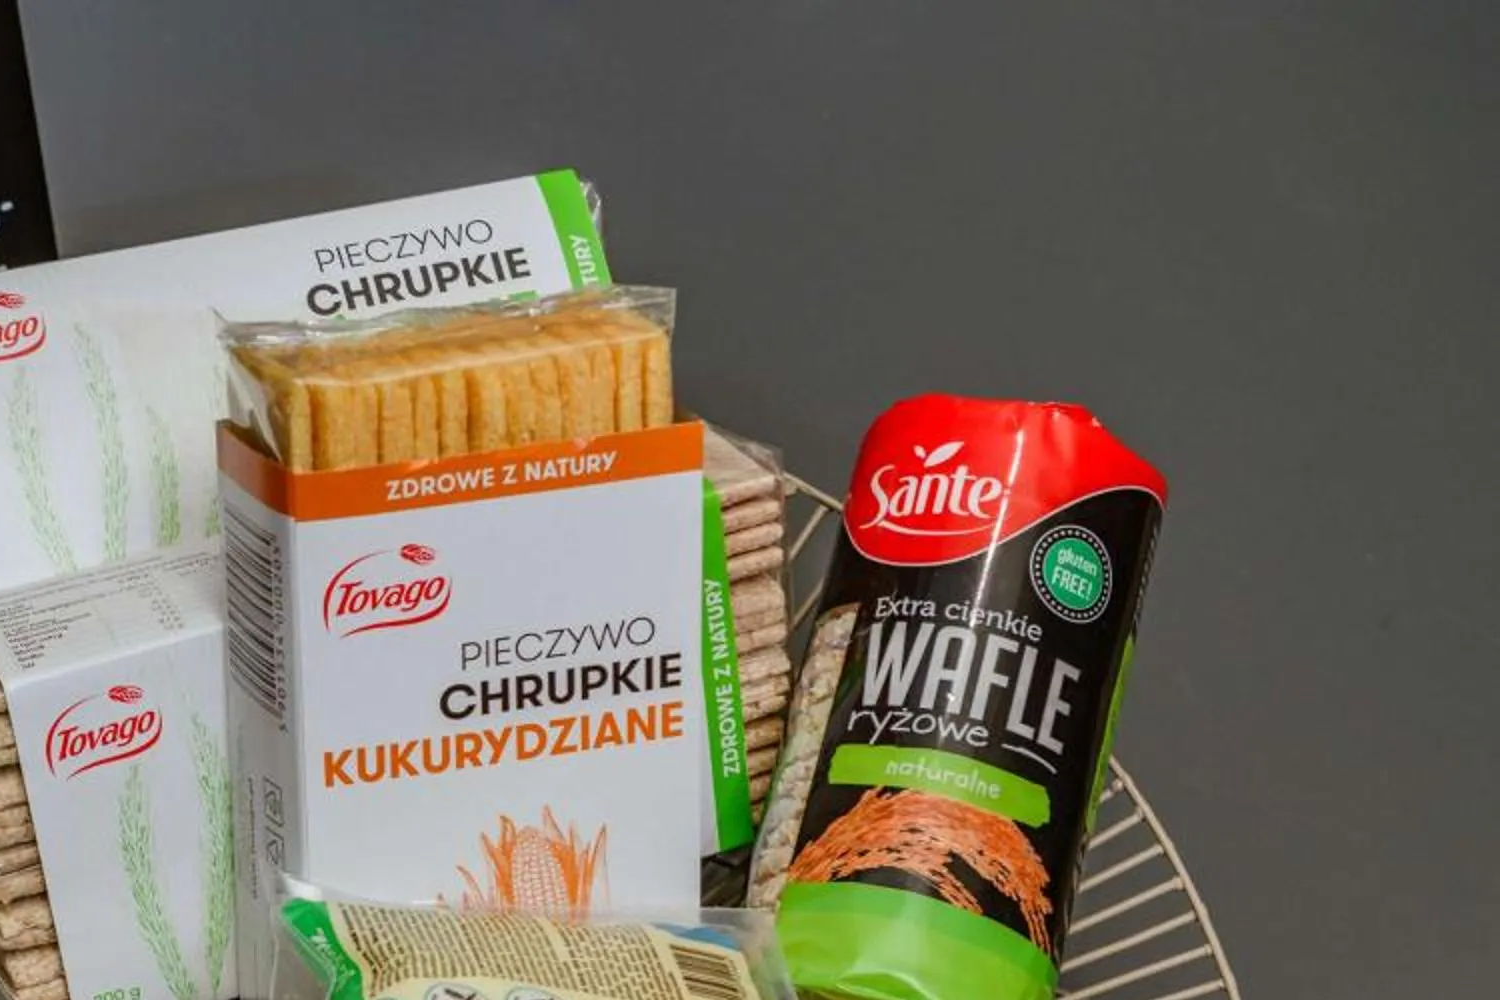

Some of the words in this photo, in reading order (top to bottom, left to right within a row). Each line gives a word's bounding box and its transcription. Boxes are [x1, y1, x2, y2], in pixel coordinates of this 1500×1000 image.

[314, 218, 494, 273] PIECZYWO
[306, 246, 533, 318] CHRUPKIE
[386, 466, 495, 501] ZDROWE
[501, 464, 517, 486] Z
[523, 450, 617, 483] NATURY
[859, 464, 1003, 529] Sante
[1051, 565, 1094, 601] FREE!
[1057, 547, 1098, 577] gluten
[336, 575, 447, 618] Tovago
[703, 579, 727, 656] NATURY
[875, 596, 936, 619] Extra
[946, 597, 1043, 643] cienkie
[460, 616, 656, 671] PIECZYWO
[440, 652, 682, 720] CHRUPKIE
[718, 663, 732, 679] Z
[861, 622, 1082, 756] WAFLE
[55, 710, 156, 762] Tovago
[322, 701, 685, 788] KUKURYDZIANE
[714, 684, 741, 778] ZDROWE
[847, 706, 990, 748] ryżowe
[884, 758, 1001, 799] naturalne
